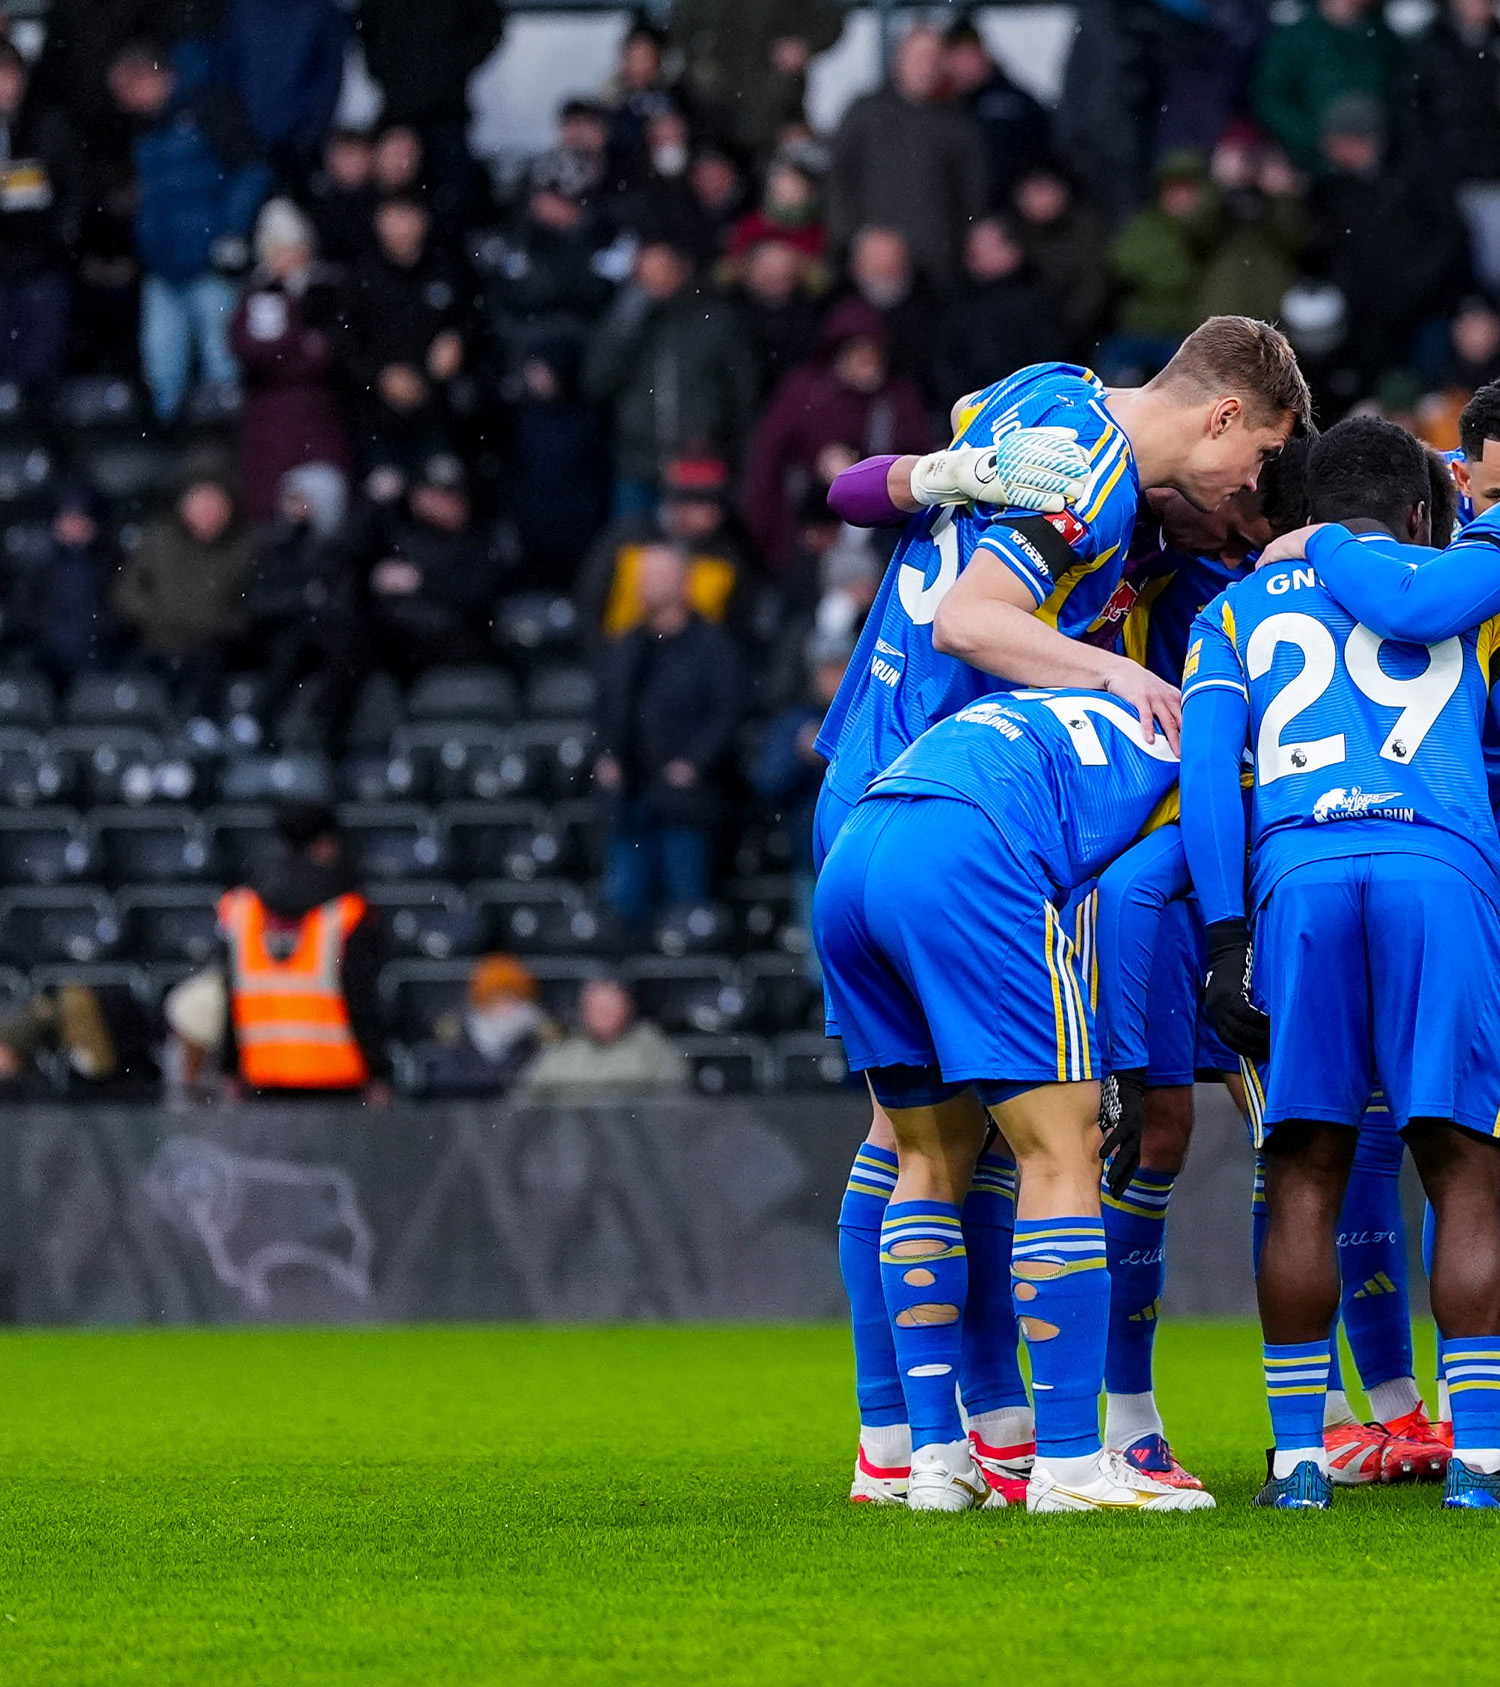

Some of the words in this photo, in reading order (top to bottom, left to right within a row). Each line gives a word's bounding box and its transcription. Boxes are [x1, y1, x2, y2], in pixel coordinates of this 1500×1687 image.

[1266, 567, 1327, 595] GN
[1247, 612, 1463, 787] 29
[1384, 808, 1414, 823] RUN
